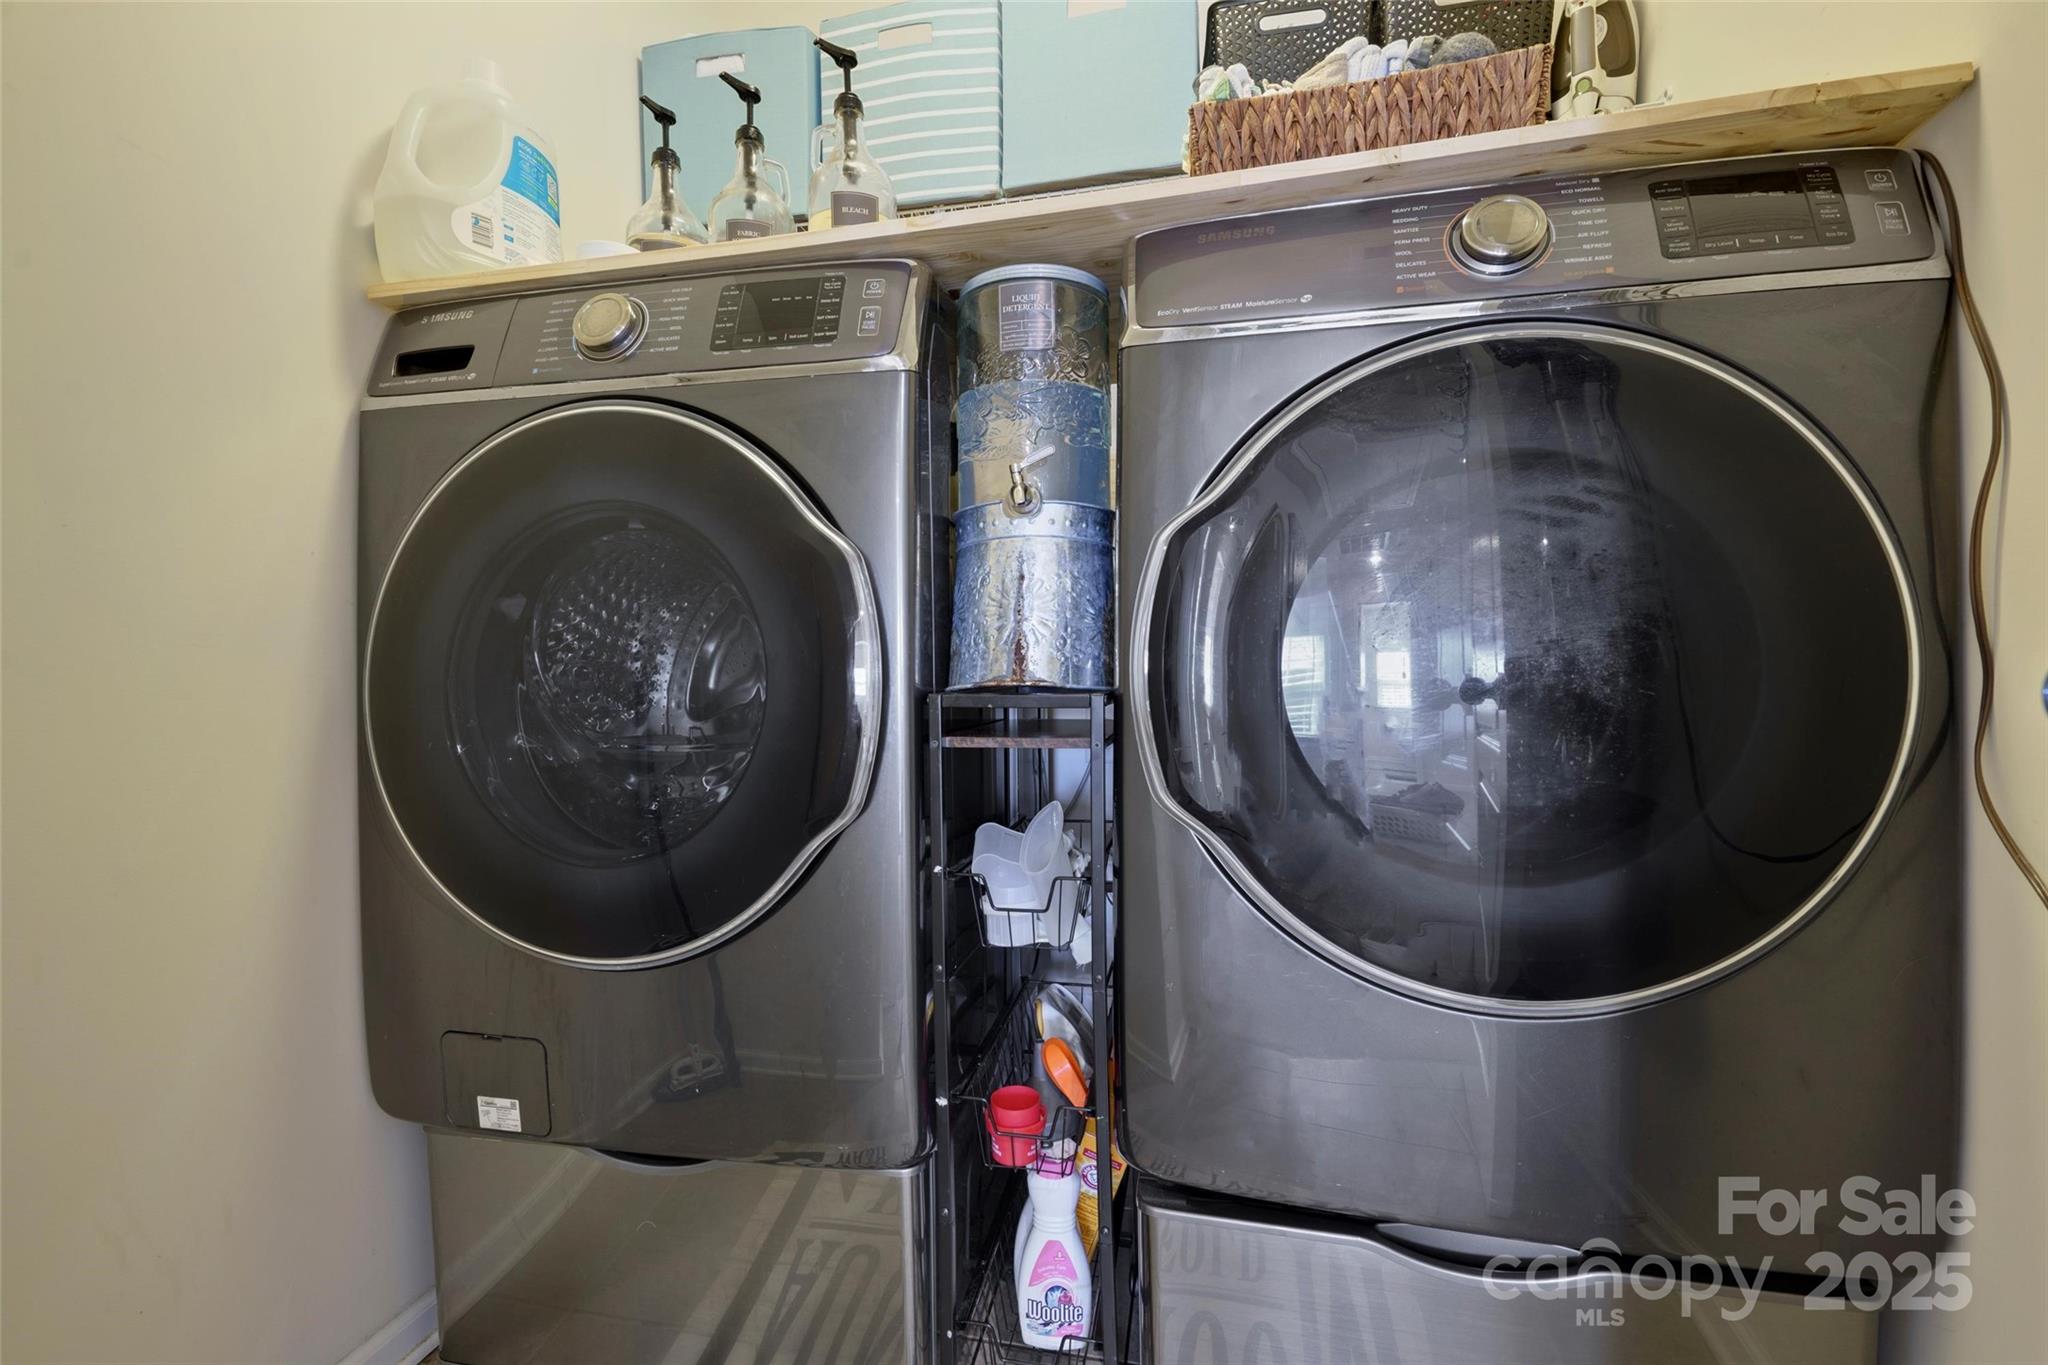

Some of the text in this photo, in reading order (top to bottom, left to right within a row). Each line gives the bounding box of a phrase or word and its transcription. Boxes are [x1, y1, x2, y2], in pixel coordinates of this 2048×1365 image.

[841, 206, 869, 215] BLEACH
[1571, 208, 1591, 216] QUICK
[737, 230, 761, 238] FABRIC
[1197, 225, 1275, 244] SAMSUNG
[1393, 227, 1419, 235] SANITIZE
[1394, 238, 1411, 246] PERM
[1582, 241, 1612, 249] REFRESH
[1395, 260, 1427, 268] DELICATES
[1563, 255, 1593, 264] WRINKLE
[1396, 272, 1417, 281] ACTIVE
[1012, 293, 1040, 303] LIQUID
[1002, 303, 1050, 313] DETERGENT
[1157, 308, 1179, 317] EcoDry
[1182, 305, 1218, 314] VentSensor
[1220, 302, 1242, 310] STEAM
[1245, 297, 1298, 308] MoistureSensor
[1026, 1299, 1083, 1324] Woolite
